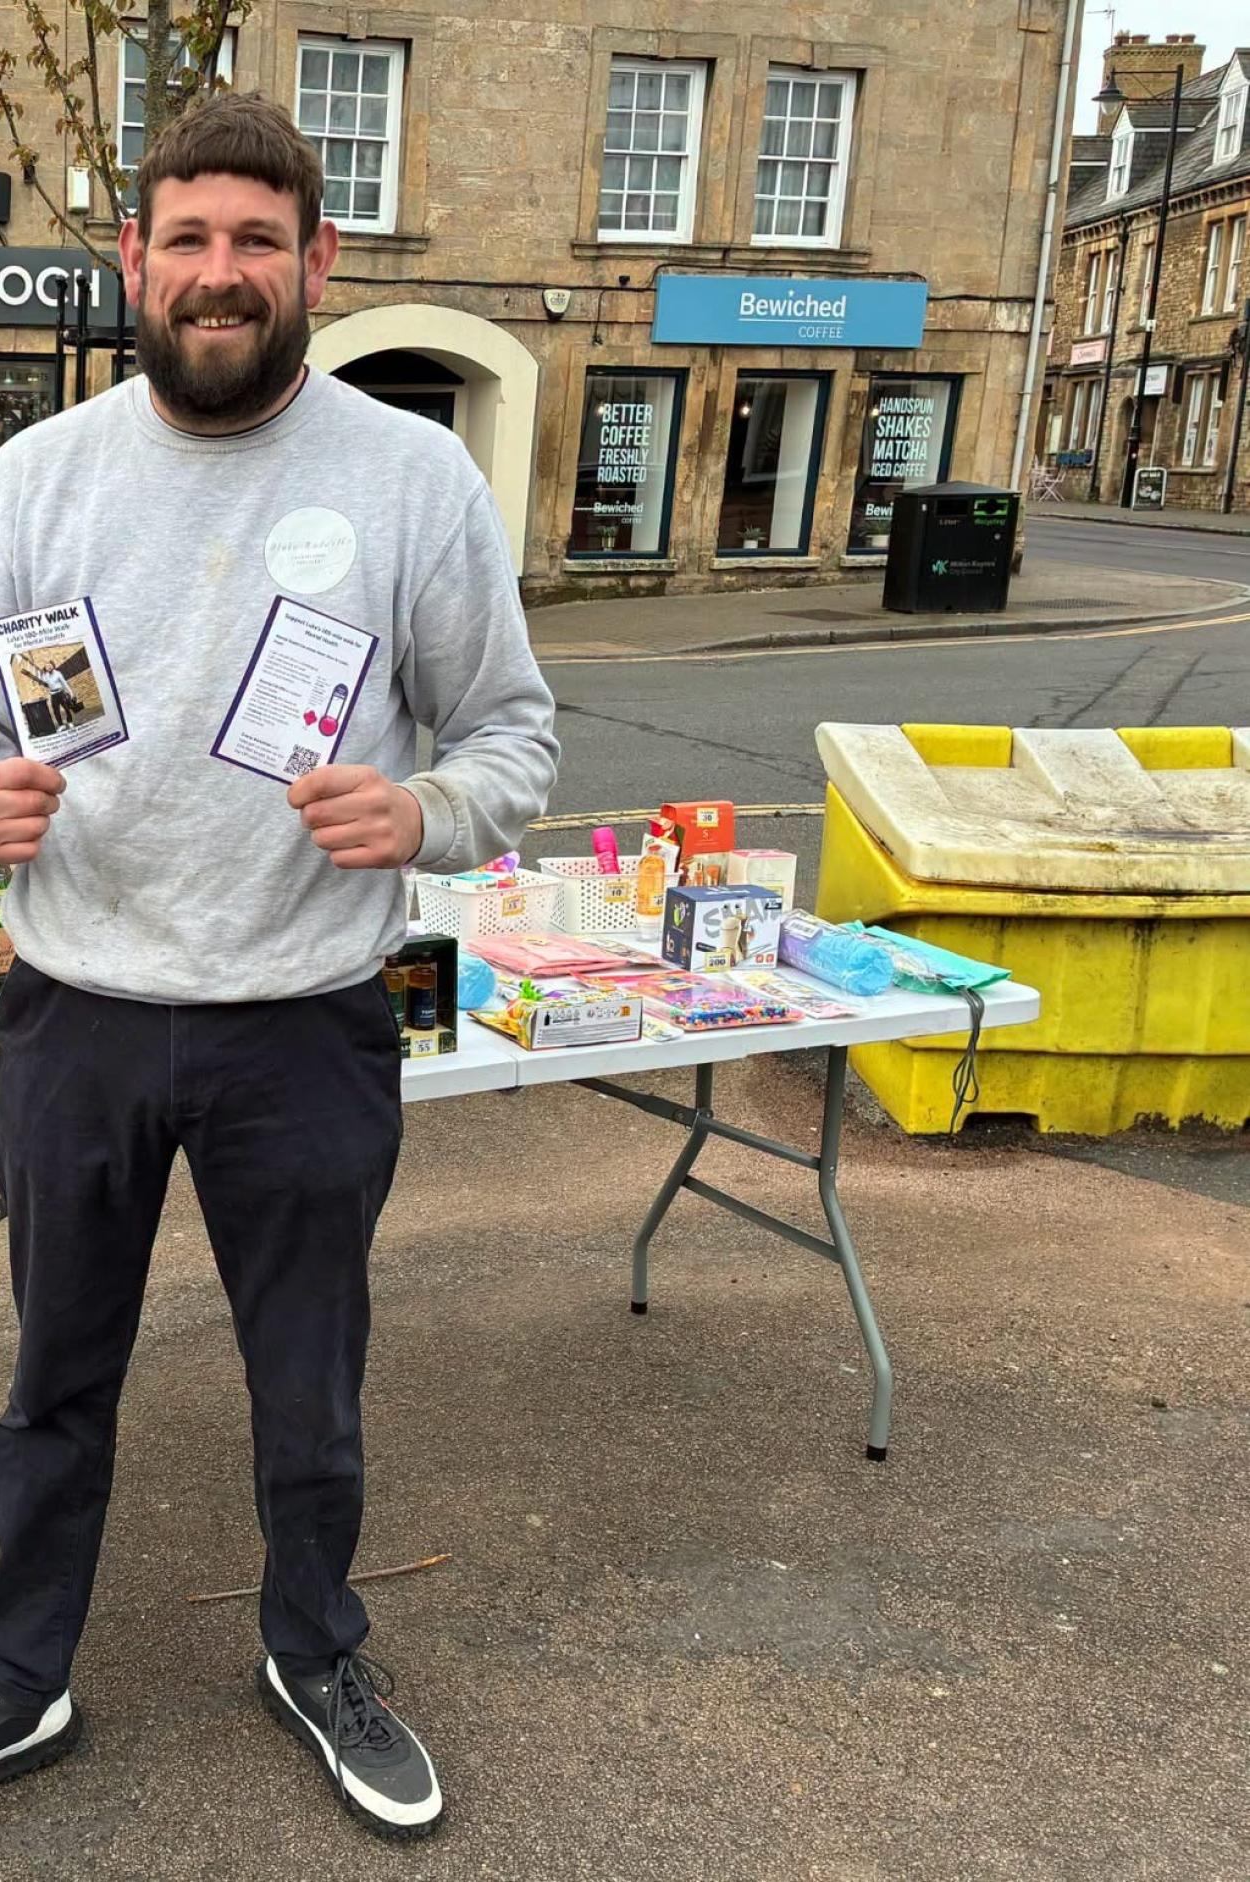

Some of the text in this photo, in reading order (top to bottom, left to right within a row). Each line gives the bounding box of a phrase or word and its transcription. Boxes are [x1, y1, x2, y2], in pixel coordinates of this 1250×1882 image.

[738, 289, 847, 318] Bewiched
[798, 326, 843, 339] COFFEE
[602, 403, 653, 424] BETTER
[879, 397, 935, 414] HANDSPUN
[876, 415, 933, 438] SHAKES
[600, 425, 651, 446] COFFEE
[598, 448, 650, 465] FRESHLY
[872, 440, 928, 460] MATCHA
[597, 466, 647, 483] ROASTED
[871, 463, 926, 477] ICED COFFEE
[593, 500, 644, 513] Bewiched
[45, 607, 79, 624] WALK
[709, 958, 726, 967] 200
